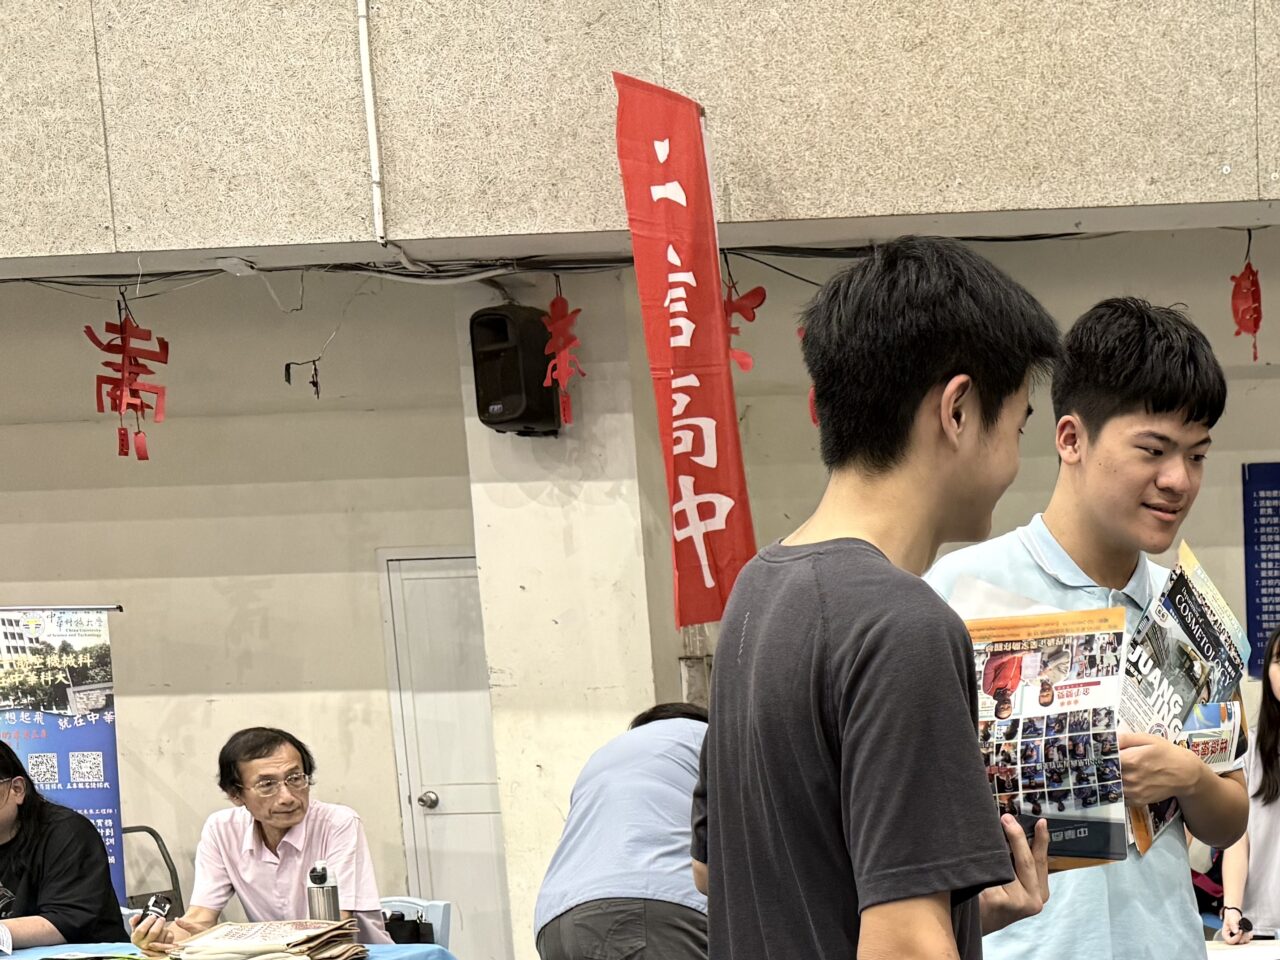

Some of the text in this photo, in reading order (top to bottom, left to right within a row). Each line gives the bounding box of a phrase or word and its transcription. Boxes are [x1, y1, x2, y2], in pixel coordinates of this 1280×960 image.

[1127, 645, 1183, 715] JUANG
[0, 711, 45, 726] 想起飛
[57, 711, 116, 730] 就在中華
